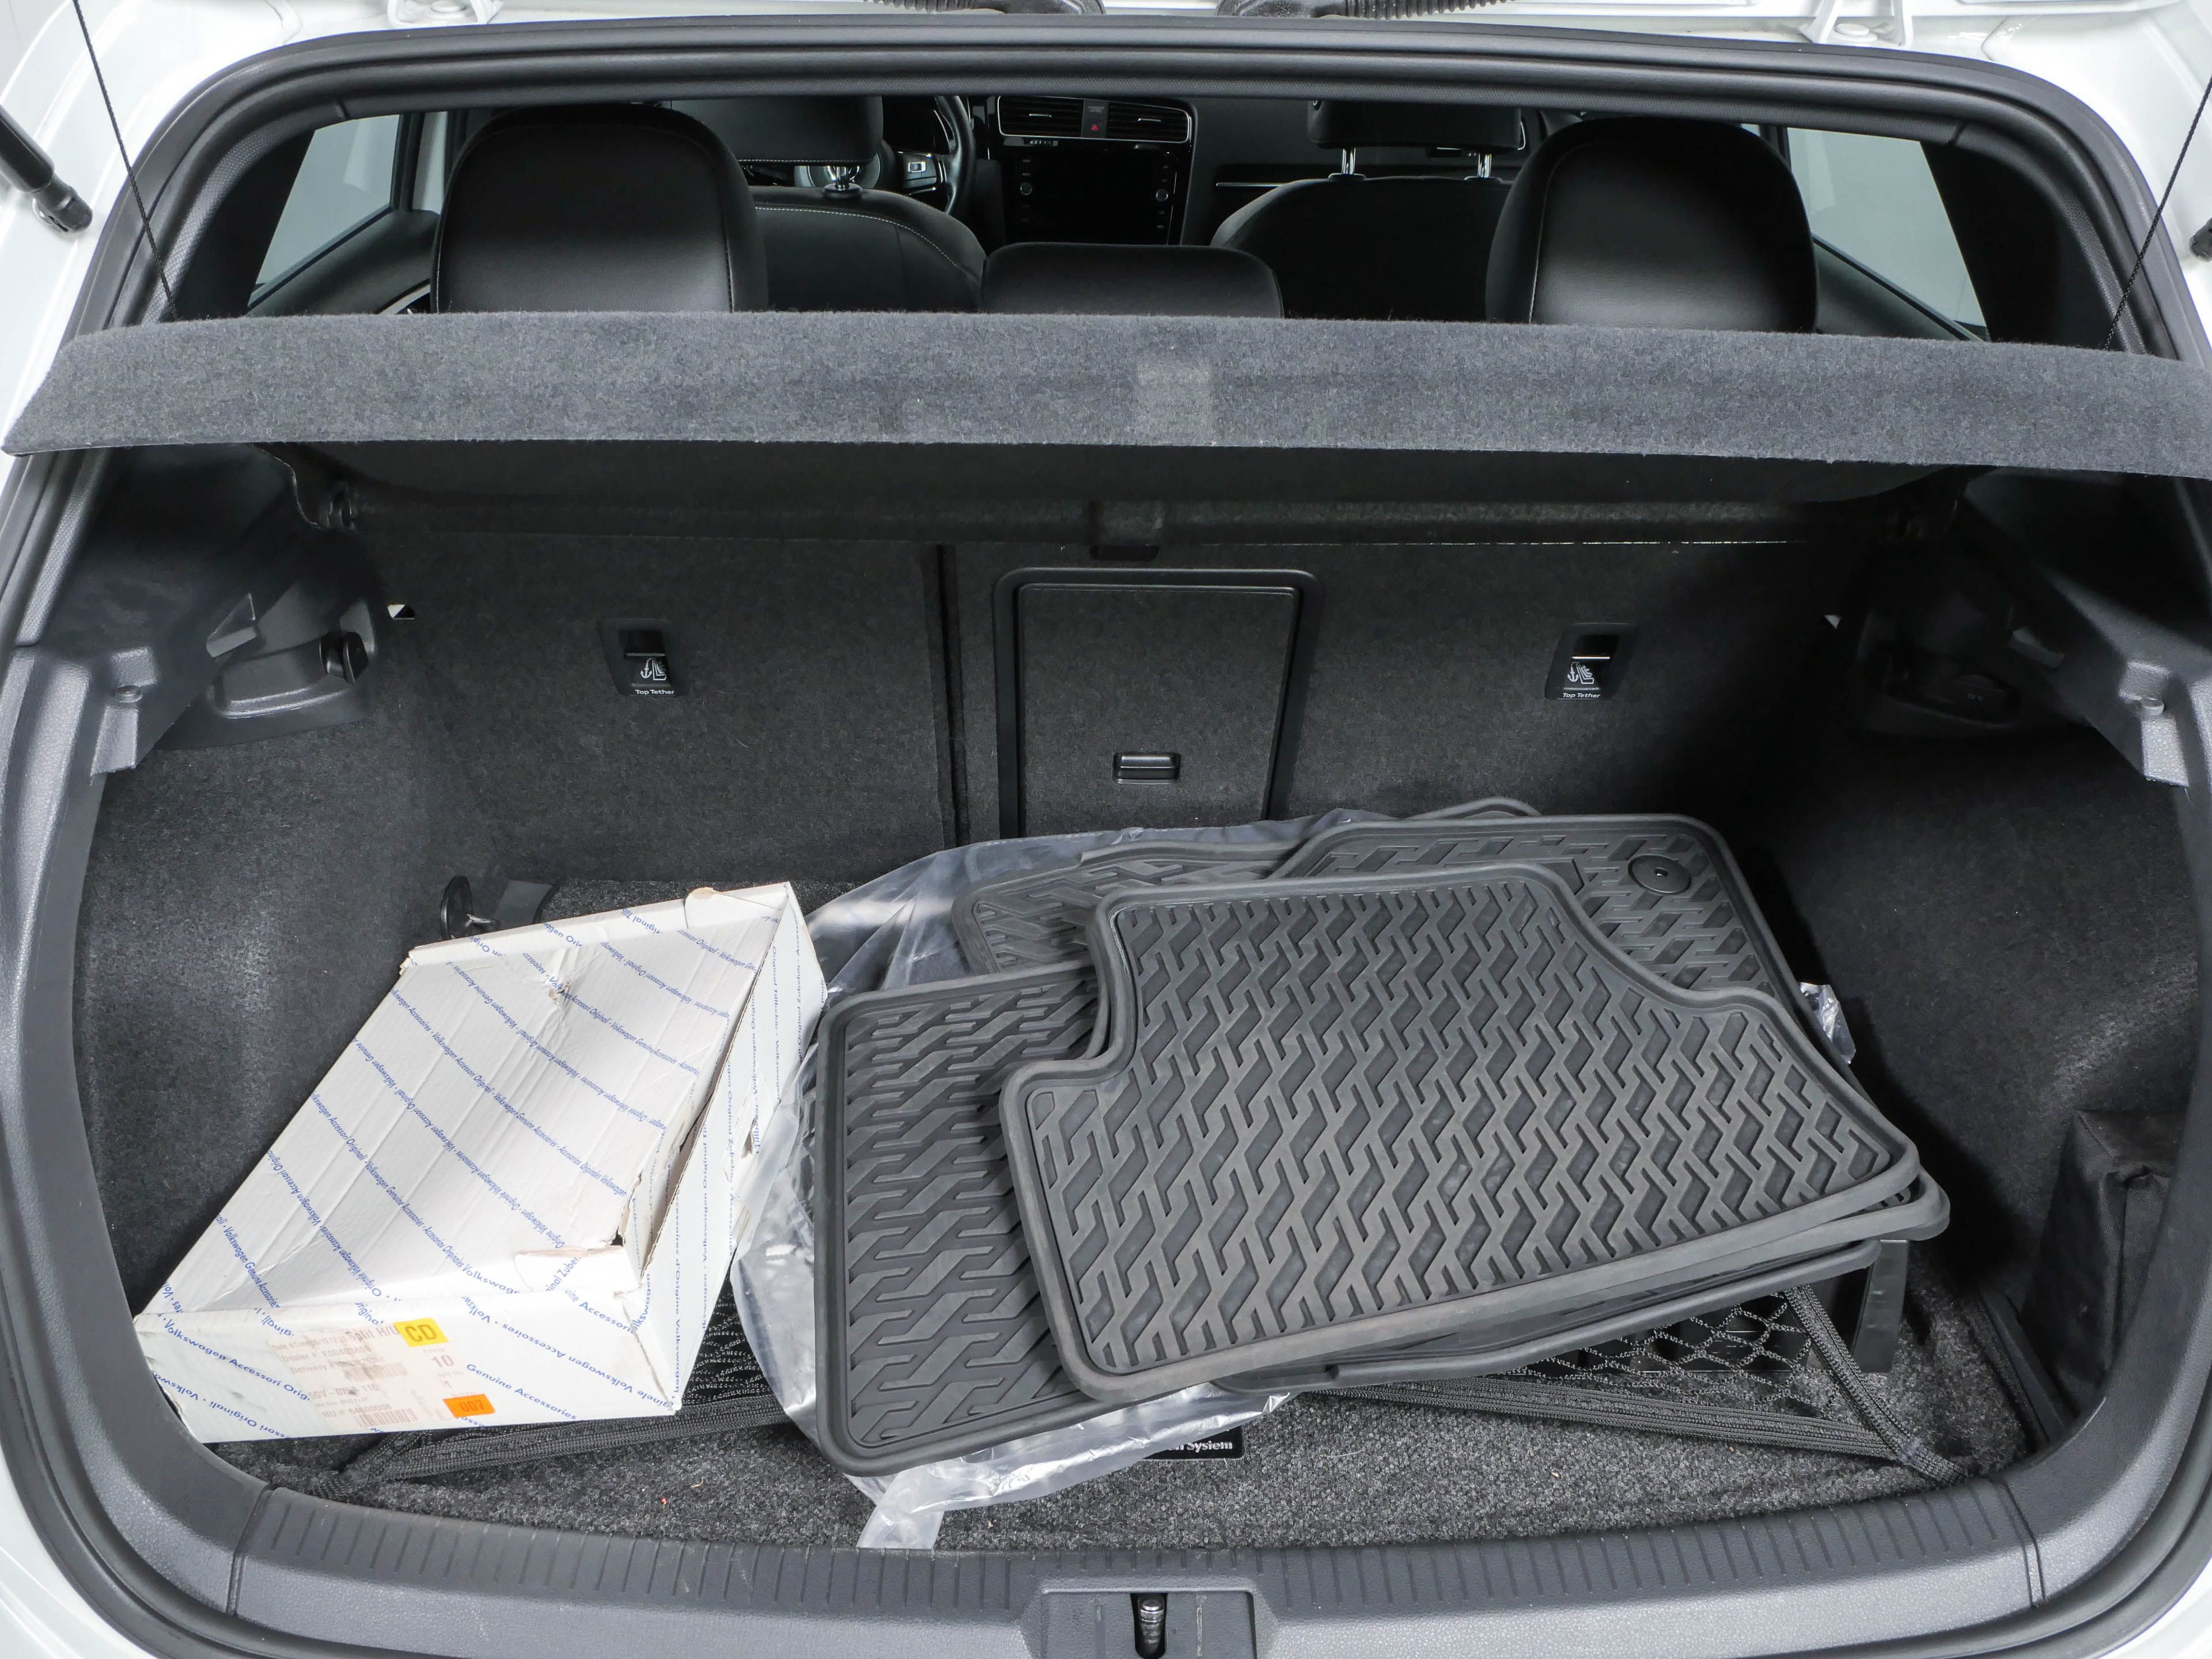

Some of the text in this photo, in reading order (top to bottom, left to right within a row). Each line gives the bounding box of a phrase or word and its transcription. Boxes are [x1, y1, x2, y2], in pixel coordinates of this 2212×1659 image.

[632, 916, 662, 934] riginal
[679, 930, 699, 942] ccessori
[600, 942, 624, 961] Volkswag
[453, 966, 476, 986] Accessories
[475, 986, 493, 1005] Genuine
[491, 1003, 517, 1028] Volkswagen
[516, 1029, 539, 1048] Originali
[611, 1022, 637, 1041] Volkswagen
[357, 1043, 373, 1061] Genuine
[390, 989, 410, 1009] lkswagen
[408, 1007, 431, 1031] Accessoires
[432, 1032, 457, 1059] Volkswagen
[454, 1056, 476, 1077] Accessori
[474, 1075, 494, 1093] Originali
[493, 1093, 518, 1116] Volkswagen
[514, 1112, 535, 1128] Genuine
[372, 1061, 396, 1088] Volkswagen
[554, 1057, 579, 1078] Volkswagen
[394, 1089, 415, 1109] Originali
[411, 1108, 433, 1127] Accessori
[431, 1126, 455, 1152] Volkswagen
[267, 1149, 282, 1171] Origina
[456, 1151, 479, 1173] Accessoires
[278, 1170, 300, 1194] Accessori
[328, 1118, 350, 1140] Accessori
[346, 1139, 368, 1160] Originali
[365, 1161, 388, 1188] Volkswagen
[387, 1187, 404, 1206] Genuine
[401, 1203, 424, 1226] Accessories
[477, 1169, 502, 1195] Volkswagen
[297, 1194, 321, 1226] Volkswagen
[521, 1210, 547, 1233] Volkswagen
[320, 1226, 343, 1253] Accessoires
[546, 1230, 565, 1248] Origine
[224, 1226, 248, 1263] Volkswagen
[245, 1262, 263, 1285] Genuine
[339, 1249, 361, 1275] Volkswagen
[172, 1301, 183, 1313] res
[355, 1302, 384, 1325] rigina
[262, 1315, 291, 1335] ginali
[346, 1328, 375, 1342] Split
[404, 1324, 437, 1342] CD
[502, 1324, 566, 1358] Accessoires
[165, 1319, 226, 1360] Volkswagen
[229, 1359, 281, 1386] Accessori
[282, 1354, 309, 1362] Dealer
[431, 1355, 454, 1368] 10
[290, 1363, 327, 1373] Delivery
[569, 1357, 632, 1392] Volkswagen
[467, 1364, 577, 1420] Genuine Accessories
[209, 1402, 257, 1426] Originali
[459, 1400, 485, 1412] 007
[1187, 1441, 1233, 1453] System
